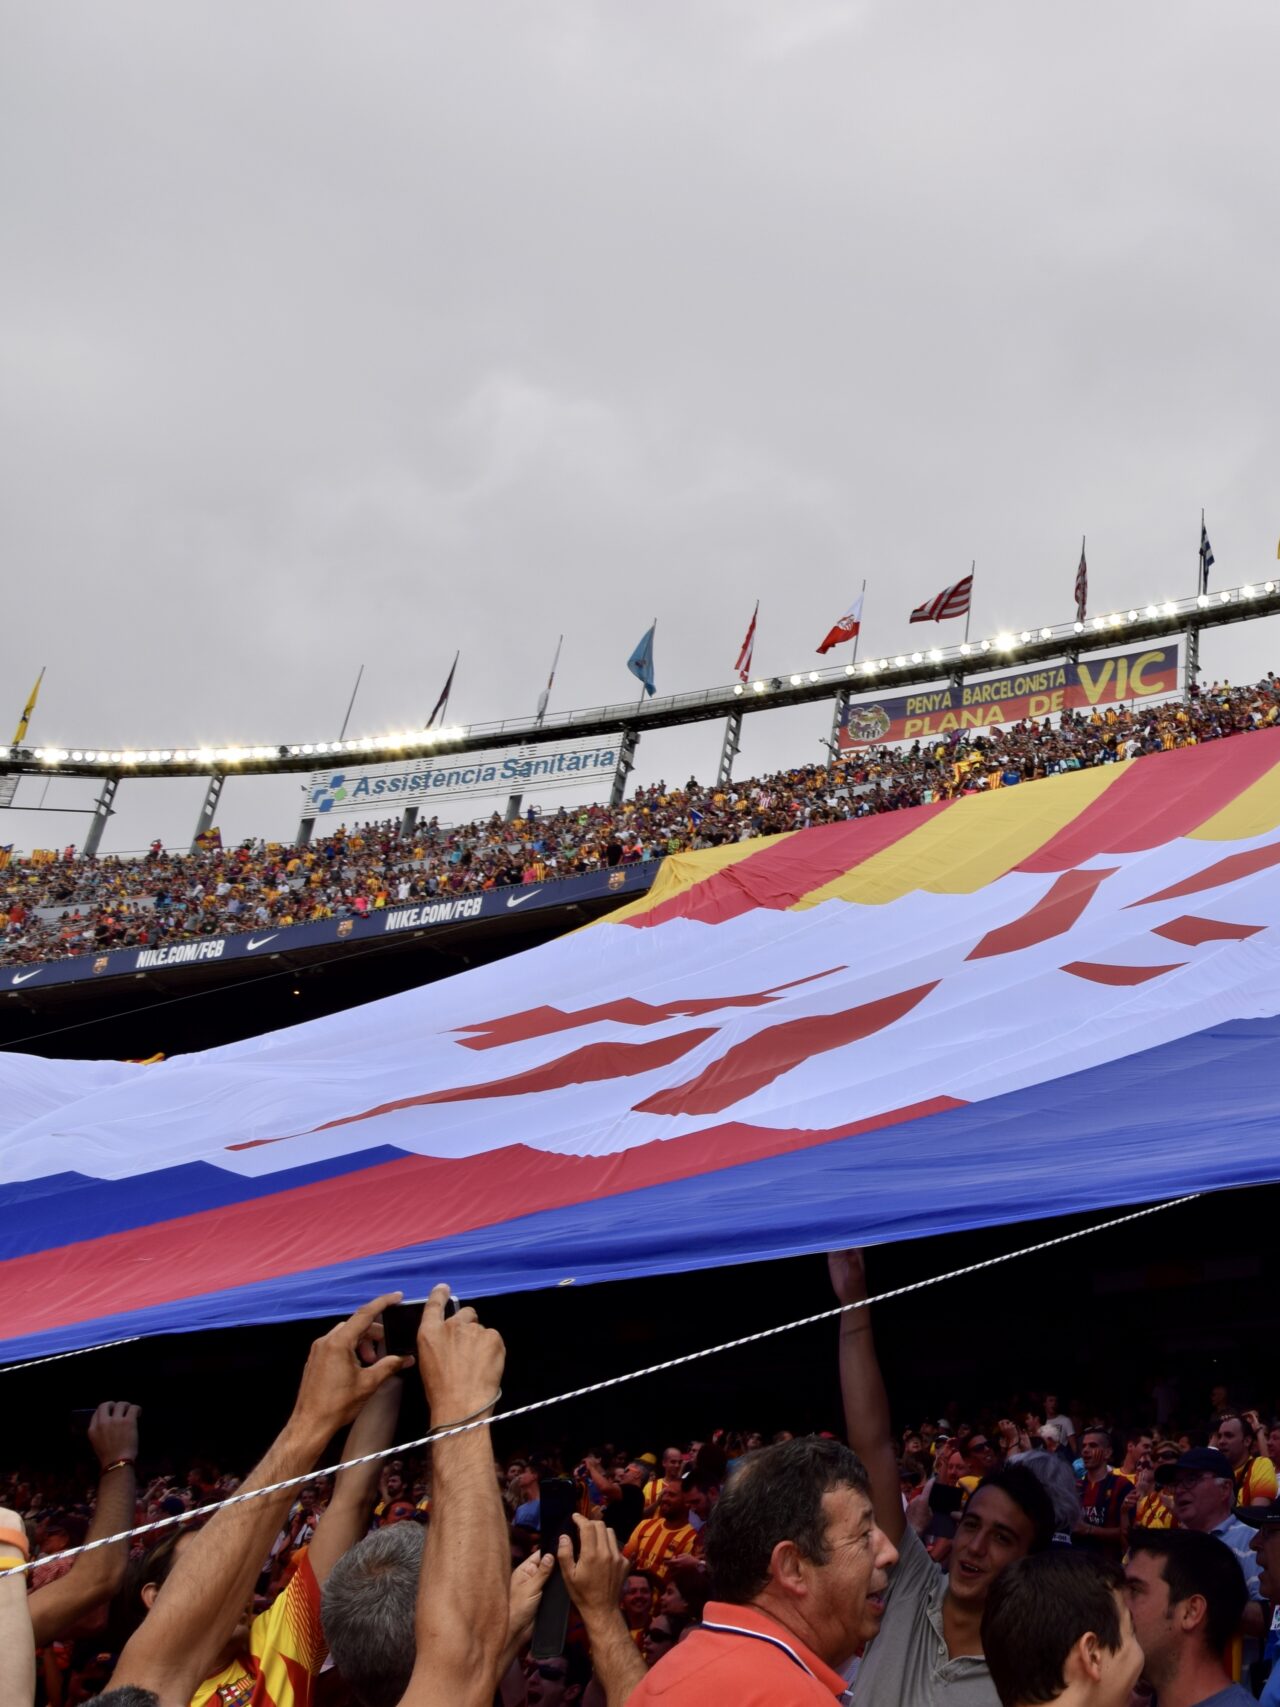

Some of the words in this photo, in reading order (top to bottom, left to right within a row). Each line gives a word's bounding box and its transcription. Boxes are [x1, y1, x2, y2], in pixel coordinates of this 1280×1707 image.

[904, 706, 1004, 739] PLANA
[1028, 690, 1065, 718] DE
[1077, 651, 1165, 705] VIC
[905, 690, 952, 716] PENYA
[962, 668, 1066, 706] BARCELONISTA
[352, 766, 497, 797] Assistència
[385, 896, 483, 931] NIKE.COM/FCB
[135, 940, 225, 968] NIKE.COM/FCB
